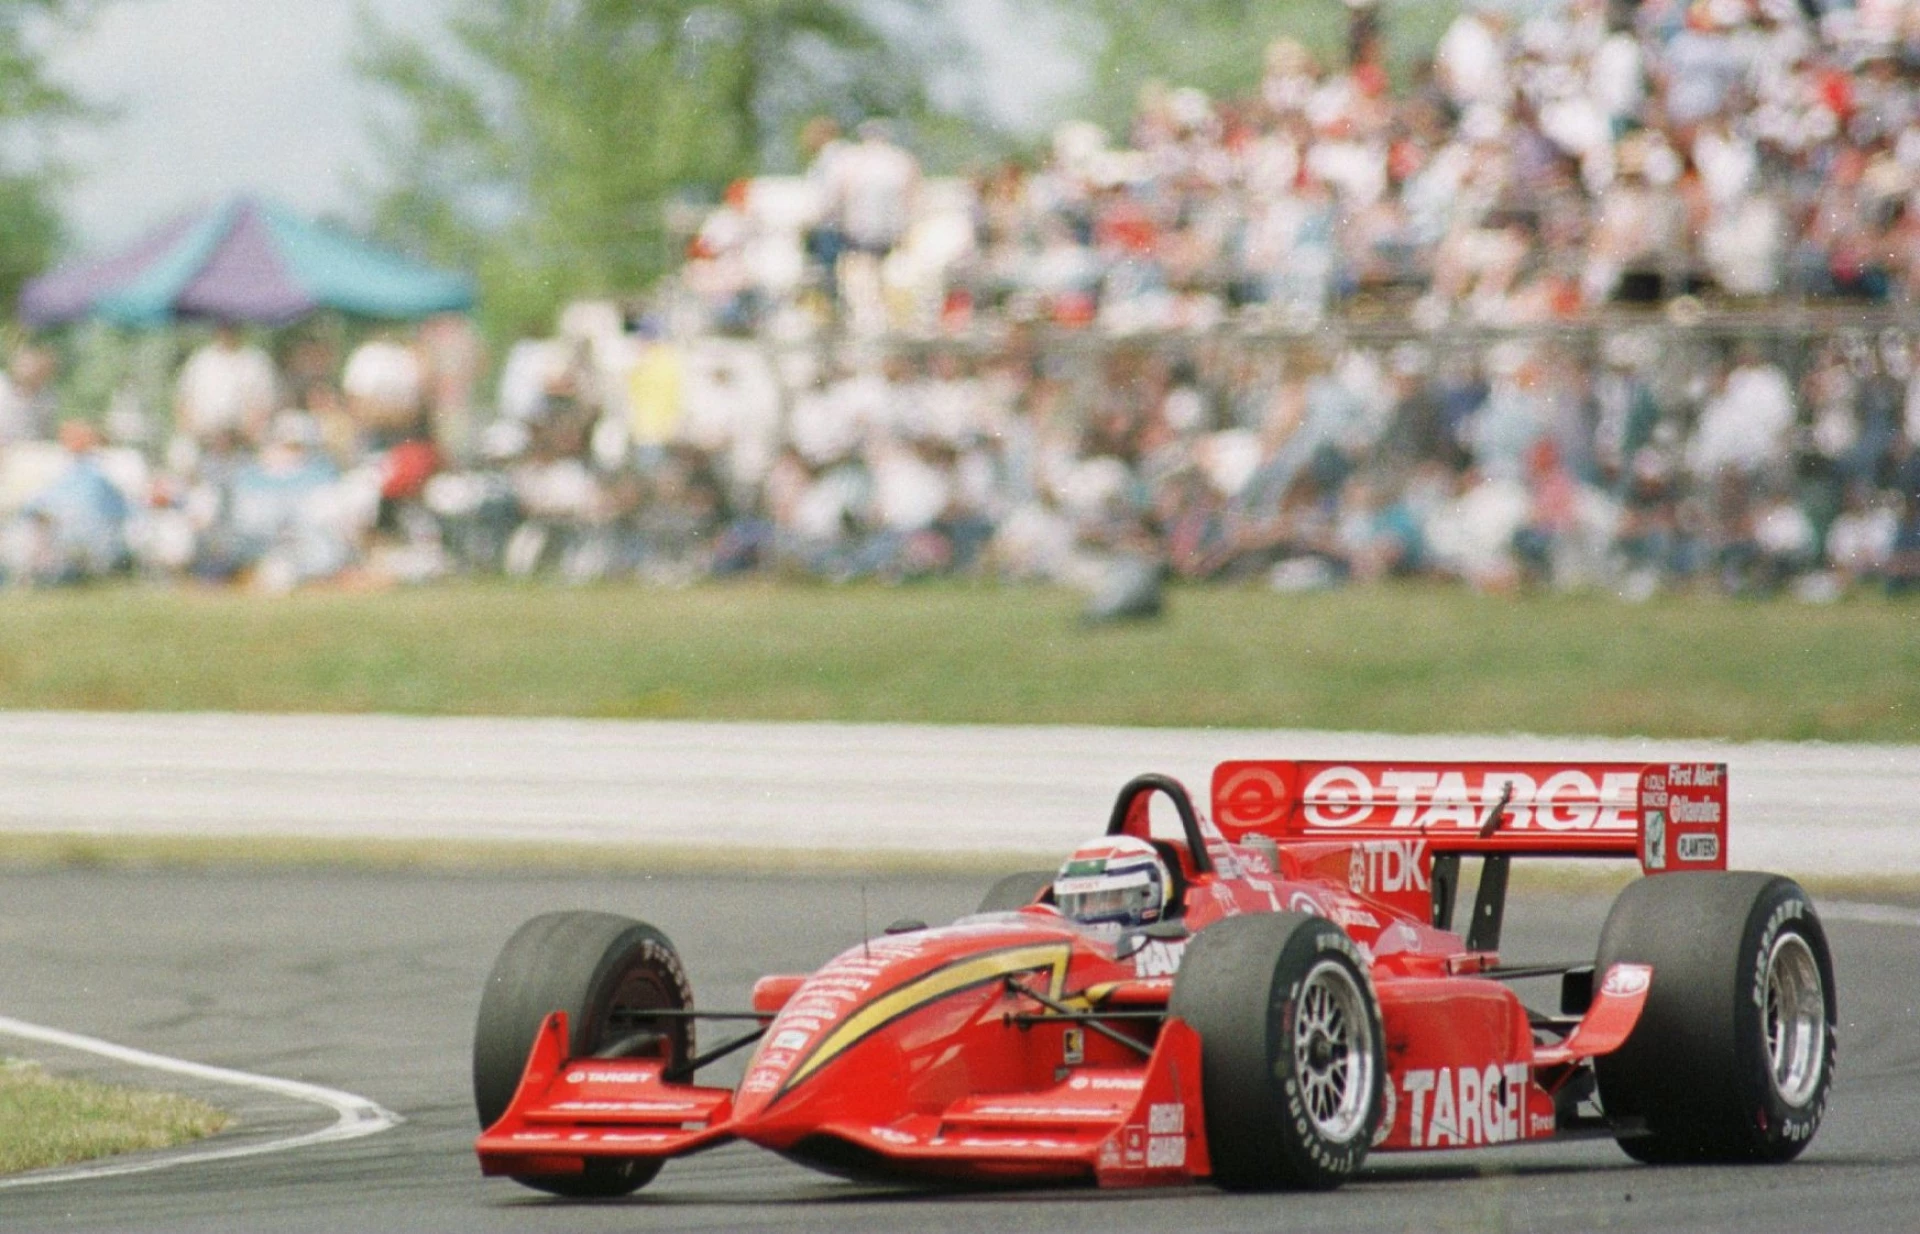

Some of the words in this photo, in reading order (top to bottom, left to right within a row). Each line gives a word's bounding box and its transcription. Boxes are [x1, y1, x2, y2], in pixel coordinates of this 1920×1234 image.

[1668, 763, 1692, 786] First
[1364, 840, 1428, 893] TDK
[1402, 1063, 1528, 1147] TARGET
